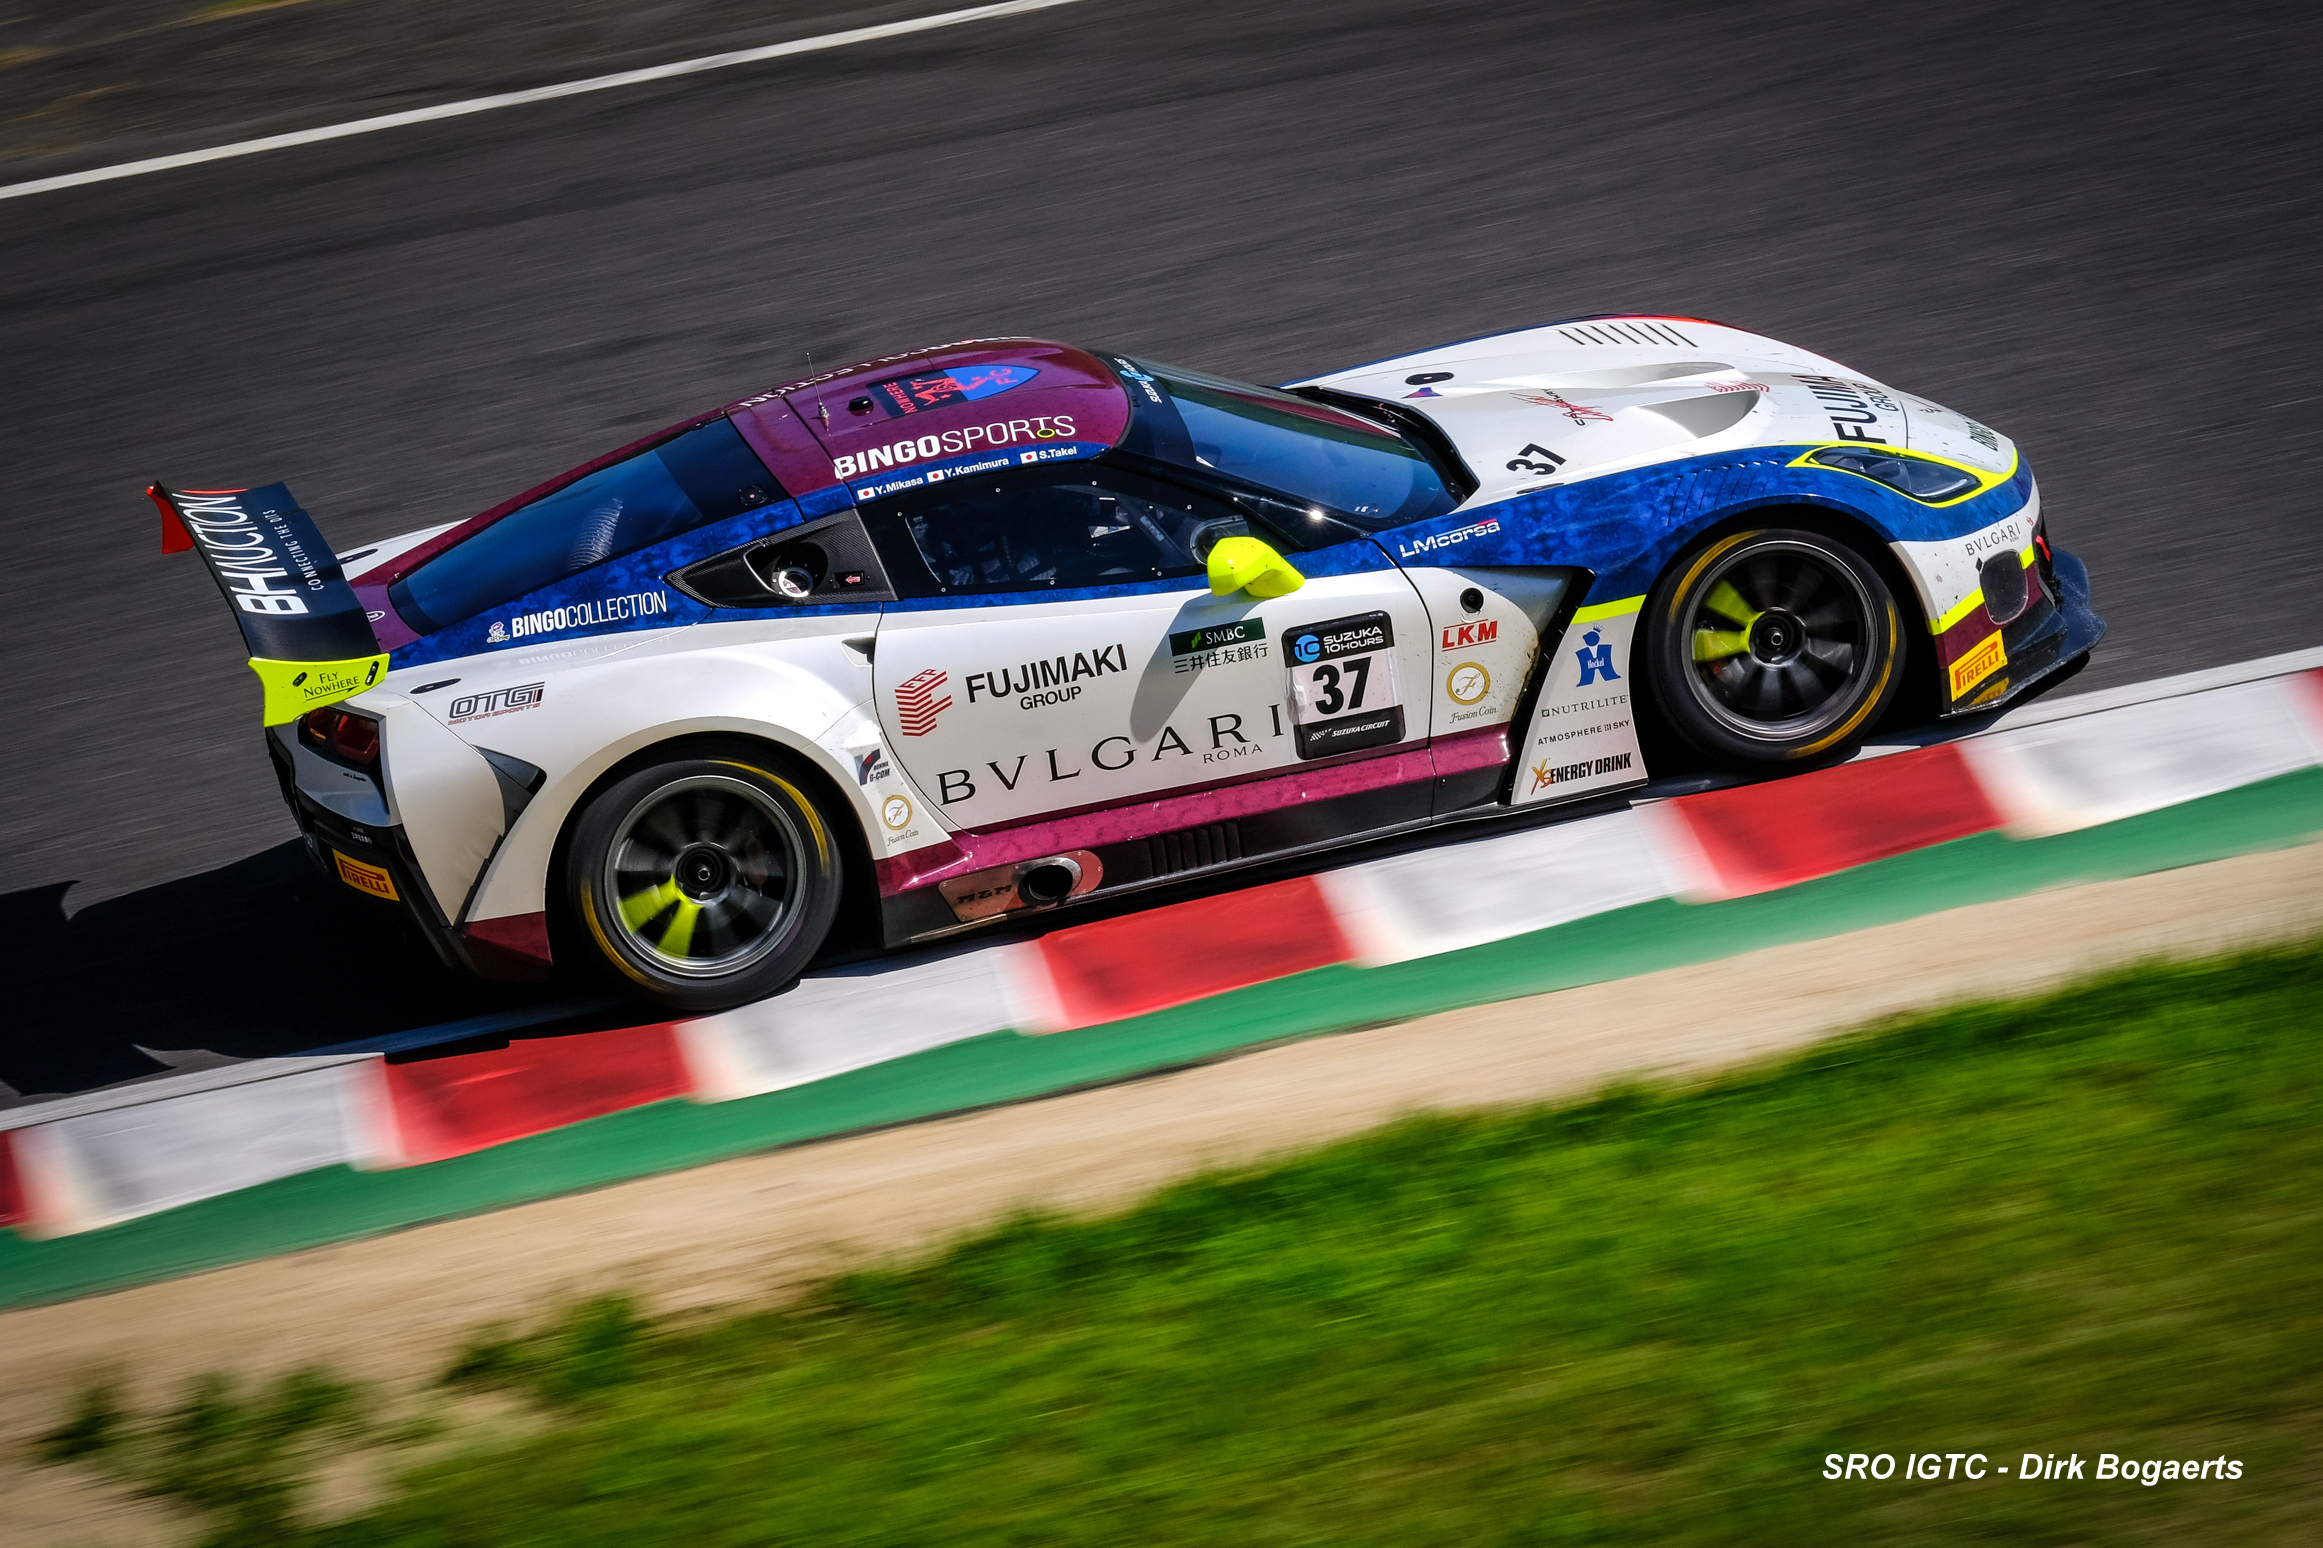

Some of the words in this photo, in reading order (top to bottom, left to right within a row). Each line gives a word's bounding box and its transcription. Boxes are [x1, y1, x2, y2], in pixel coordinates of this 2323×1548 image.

[882, 381, 919, 415] NOWHERE
[1852, 382, 1900, 412] GROUP
[943, 456, 1010, 478] Y.Kamimura
[1505, 442, 1568, 476] 37
[874, 476, 924, 495] Y.Mikasa
[273, 523, 293, 540] THE
[1399, 519, 1500, 558] LMcorsa
[1964, 521, 2021, 556] BVLGARI
[284, 539, 325, 592] CONNECTING
[1205, 625, 1246, 645] SMBC
[1323, 625, 1384, 646] SUZUKA
[1441, 620, 1498, 650] LKM
[1172, 642, 1269, 674] 三井住友銀行
[1955, 641, 2000, 692] PIRELLI
[303, 675, 361, 699] NOWHERE
[318, 670, 339, 684] FLY
[964, 643, 1128, 704] FUJIMAKI
[1311, 655, 1373, 717] 37
[491, 702, 541, 718] SPORTS
[1019, 685, 1082, 711] GROUP
[1551, 694, 1629, 717] NUTRILITE
[1449, 709, 1478, 724] Fusion
[1478, 705, 1498, 717] Coin
[1537, 725, 1603, 746] ATMOSPHERE
[1613, 719, 1630, 730] SKY
[935, 703, 1285, 807] BVLGARI
[1202, 743, 1264, 765] ROMA
[1550, 760, 1594, 785] ENERGY
[1594, 752, 1632, 776] DRINK
[905, 829, 919, 840] Coin
[337, 857, 391, 895] PIRELLI
